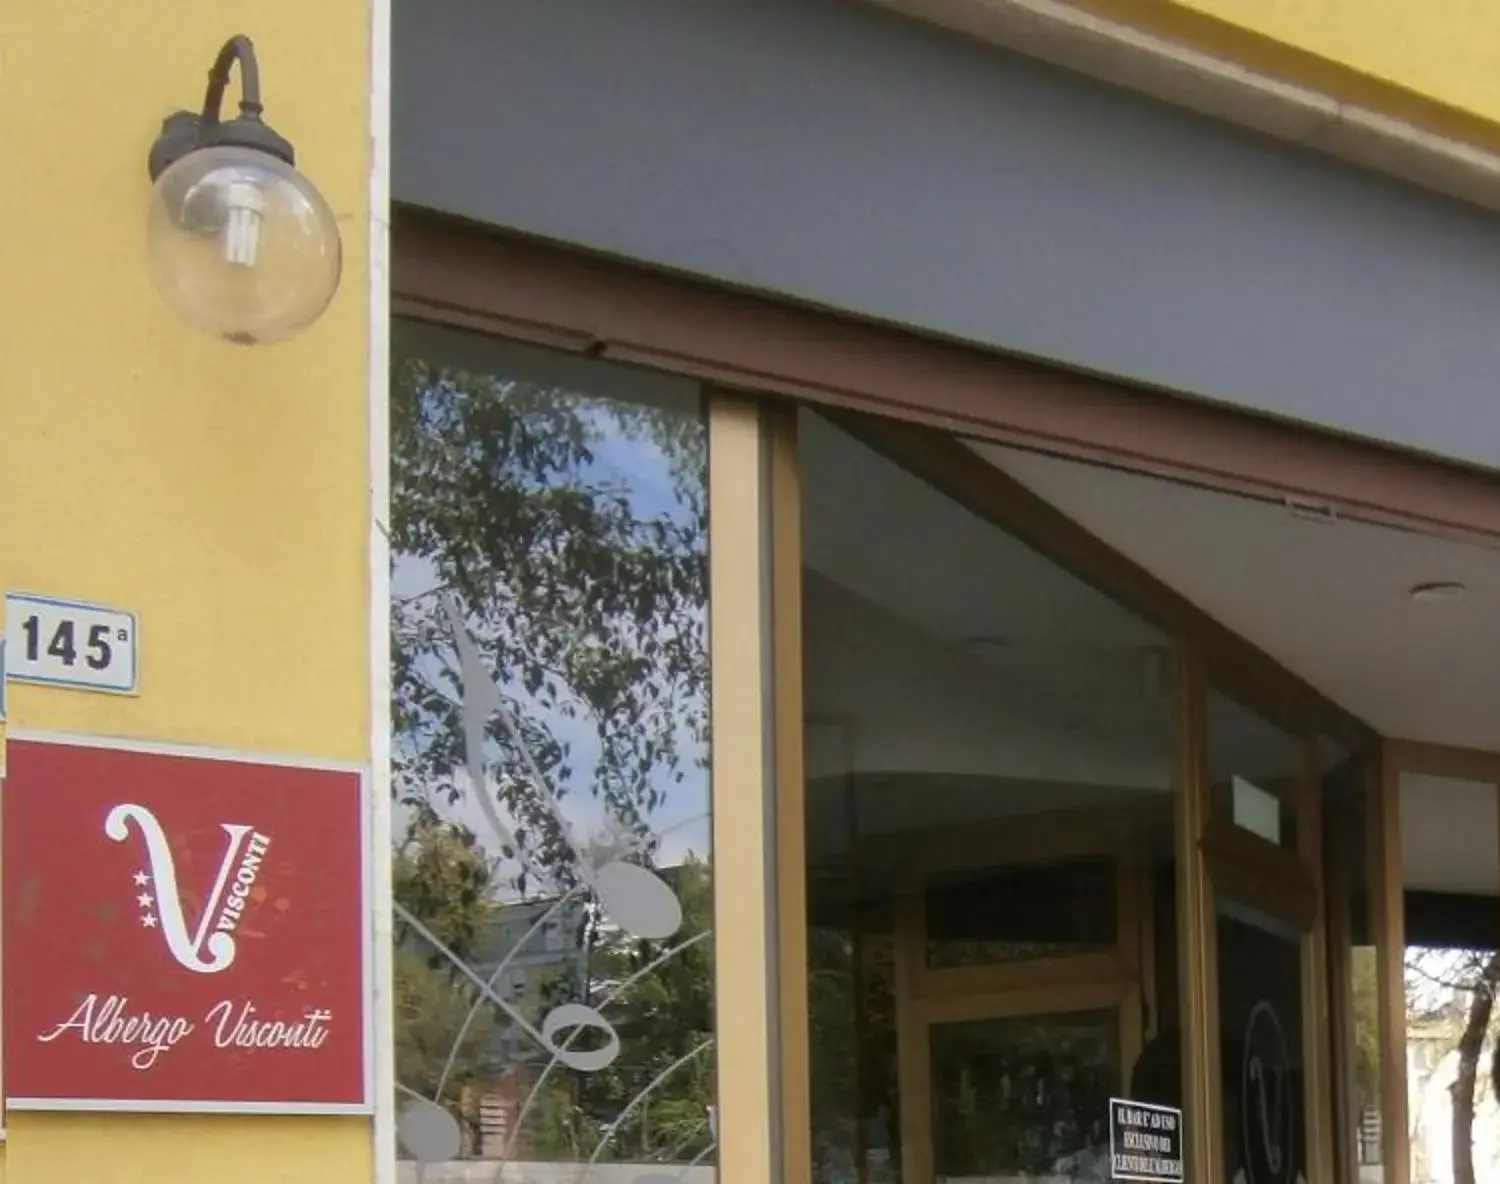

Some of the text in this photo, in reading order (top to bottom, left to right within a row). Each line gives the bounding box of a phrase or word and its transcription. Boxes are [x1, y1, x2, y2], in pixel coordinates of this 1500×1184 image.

[216, 831, 271, 931] VISCONTI
[38, 994, 332, 1069] Albergo Visconti
